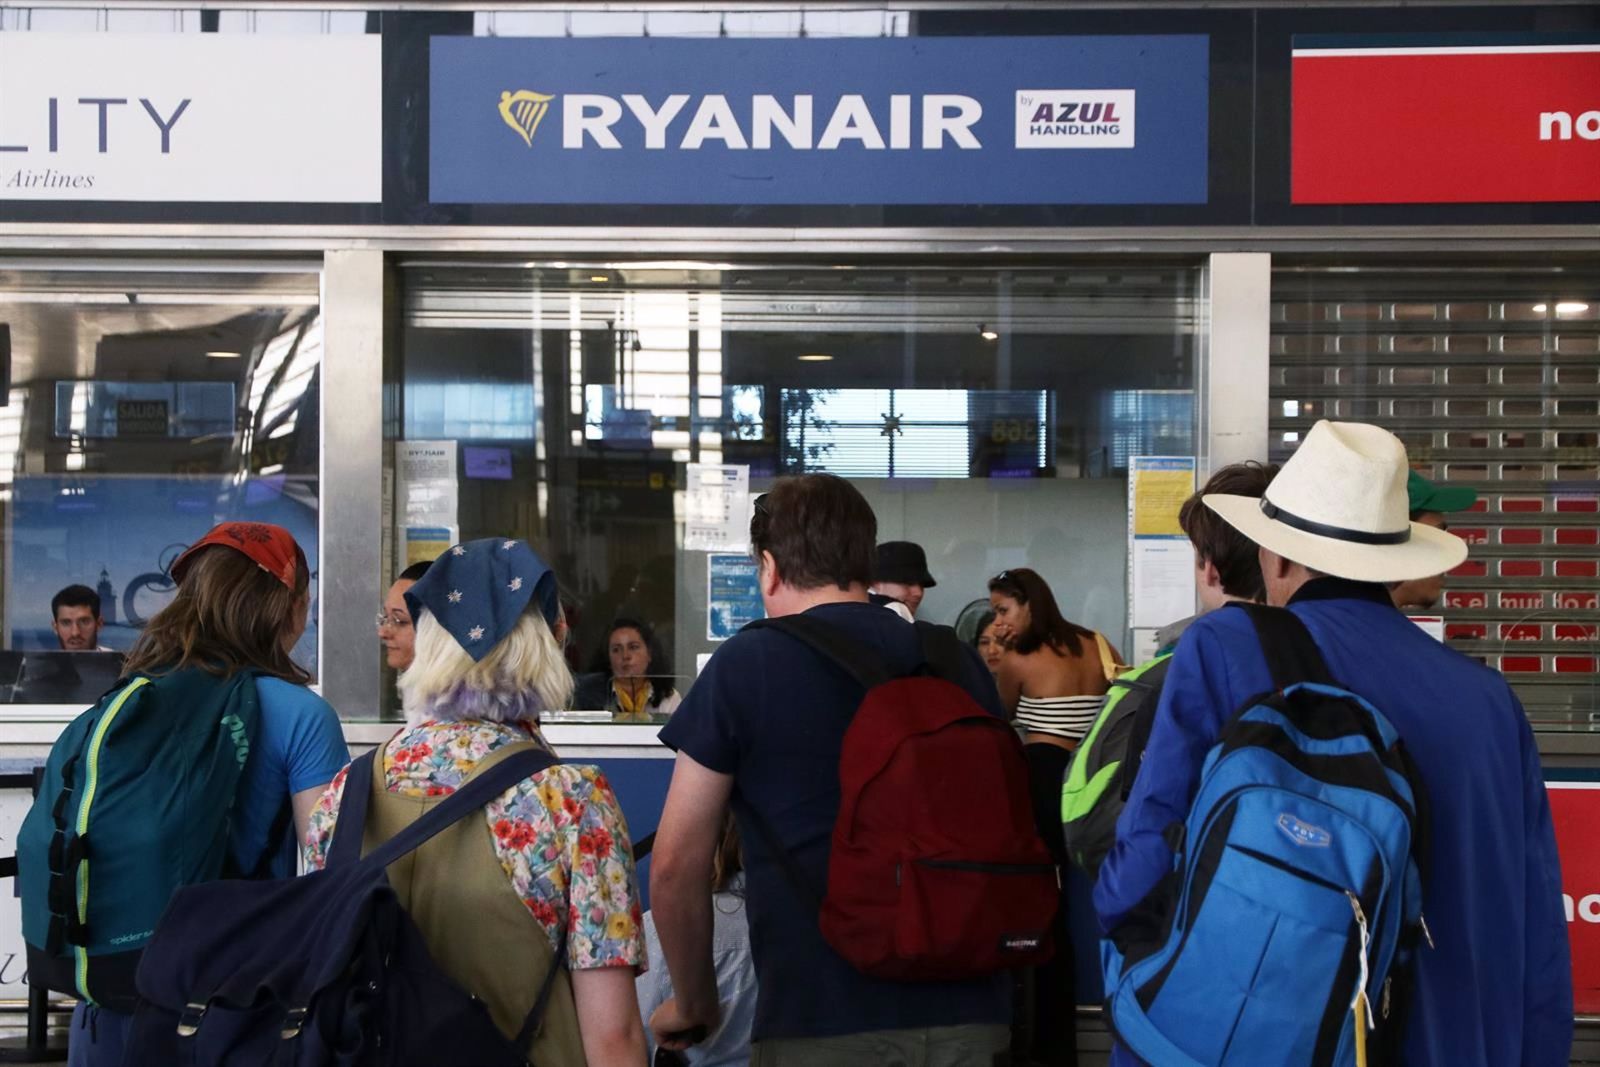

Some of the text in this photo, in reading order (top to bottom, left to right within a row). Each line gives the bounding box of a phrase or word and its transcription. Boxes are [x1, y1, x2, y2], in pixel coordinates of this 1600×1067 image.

[562, 93, 983, 150] RYANAIR
[1020, 95, 1120, 123] by AZUL
[1030, 125, 1120, 136] HANDLING
[1539, 110, 1600, 141] no
[7, 168, 95, 189] Airlines
